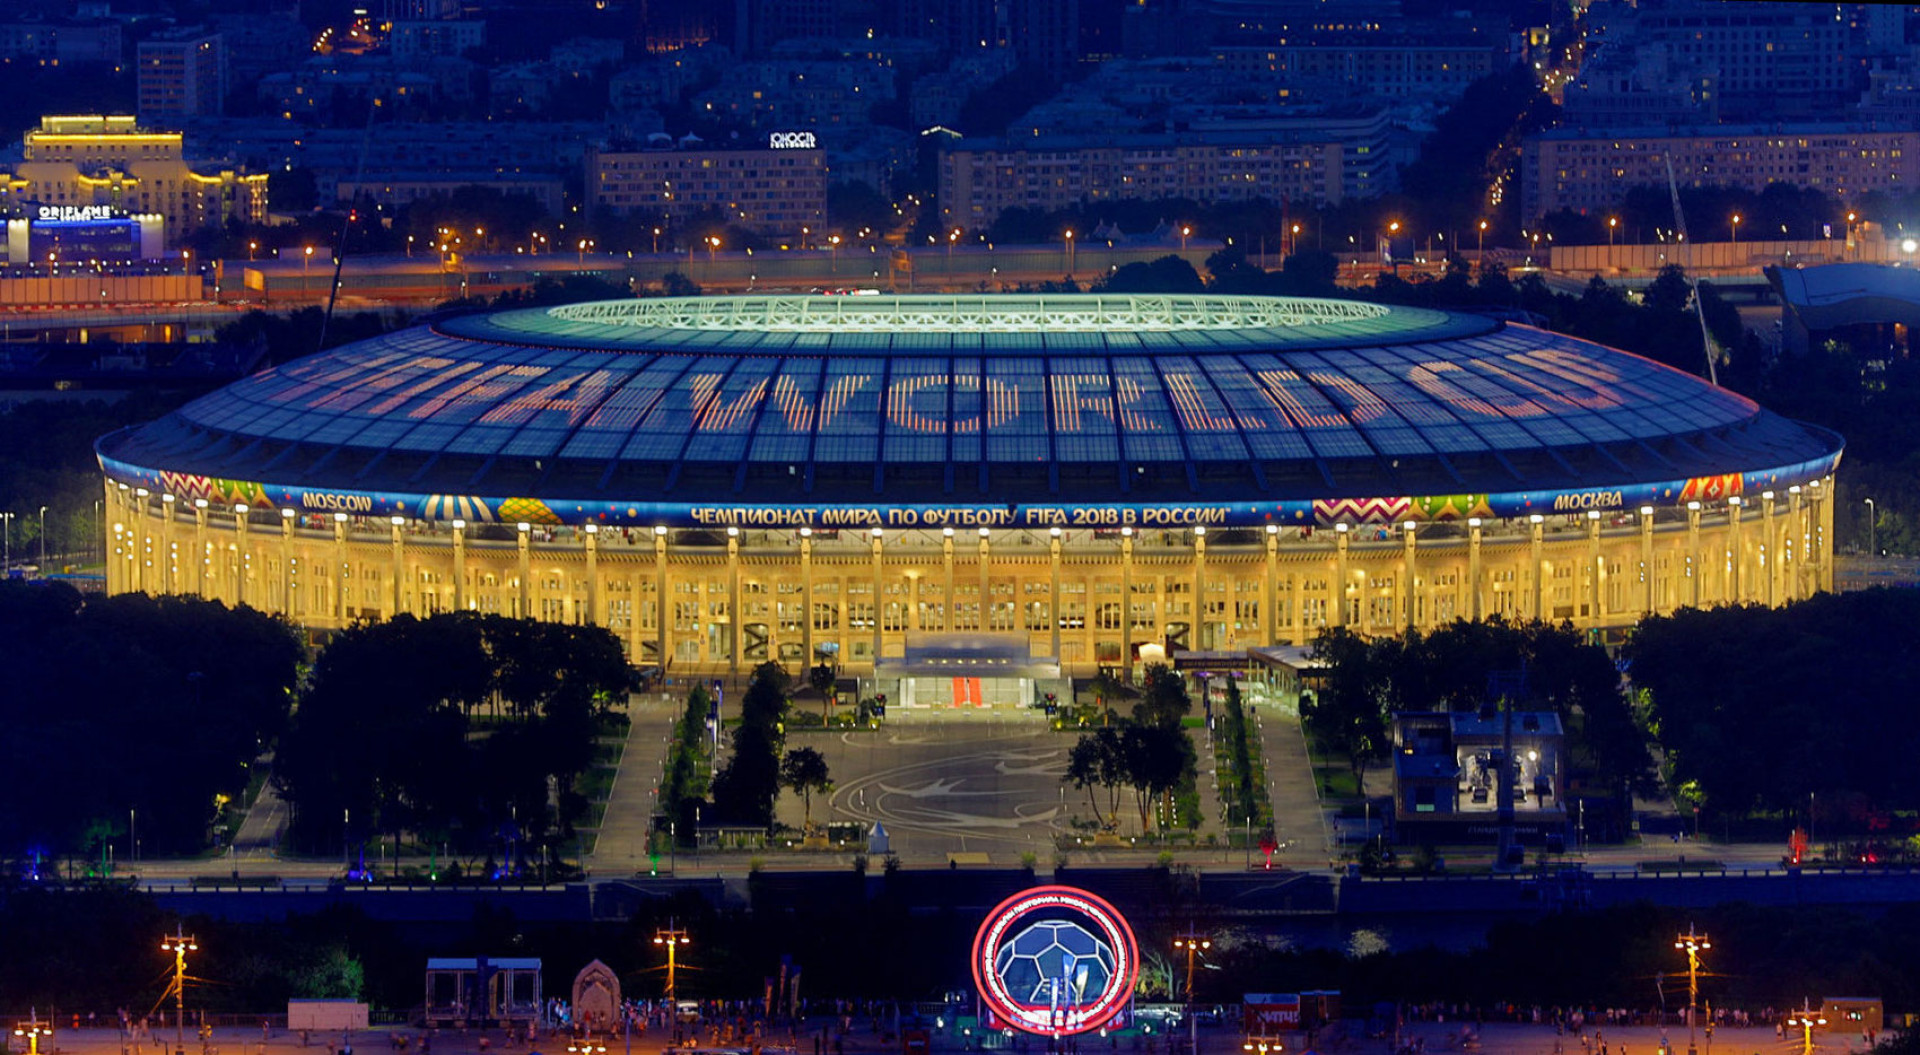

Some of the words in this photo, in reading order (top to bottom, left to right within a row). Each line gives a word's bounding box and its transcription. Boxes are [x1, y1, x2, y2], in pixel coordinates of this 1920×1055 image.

[38, 205, 111, 219] ORIFLAME
[305, 355, 614, 427] FIFA
[689, 370, 1387, 432] WORLD
[302, 491, 372, 512] MOSCOW
[1553, 490, 1623, 511] МОСКВА
[690, 508, 818, 525] ЧЕМПИОНАТ
[821, 508, 882, 525] МИРА
[888, 508, 918, 525] ПО
[922, 507, 1018, 526] ФУТБОЛУ
[1025, 508, 1068, 525] FIFA
[1072, 508, 1119, 525] 2018
[1122, 508, 1137, 525] В
[1142, 508, 1227, 525] РОССИИ
